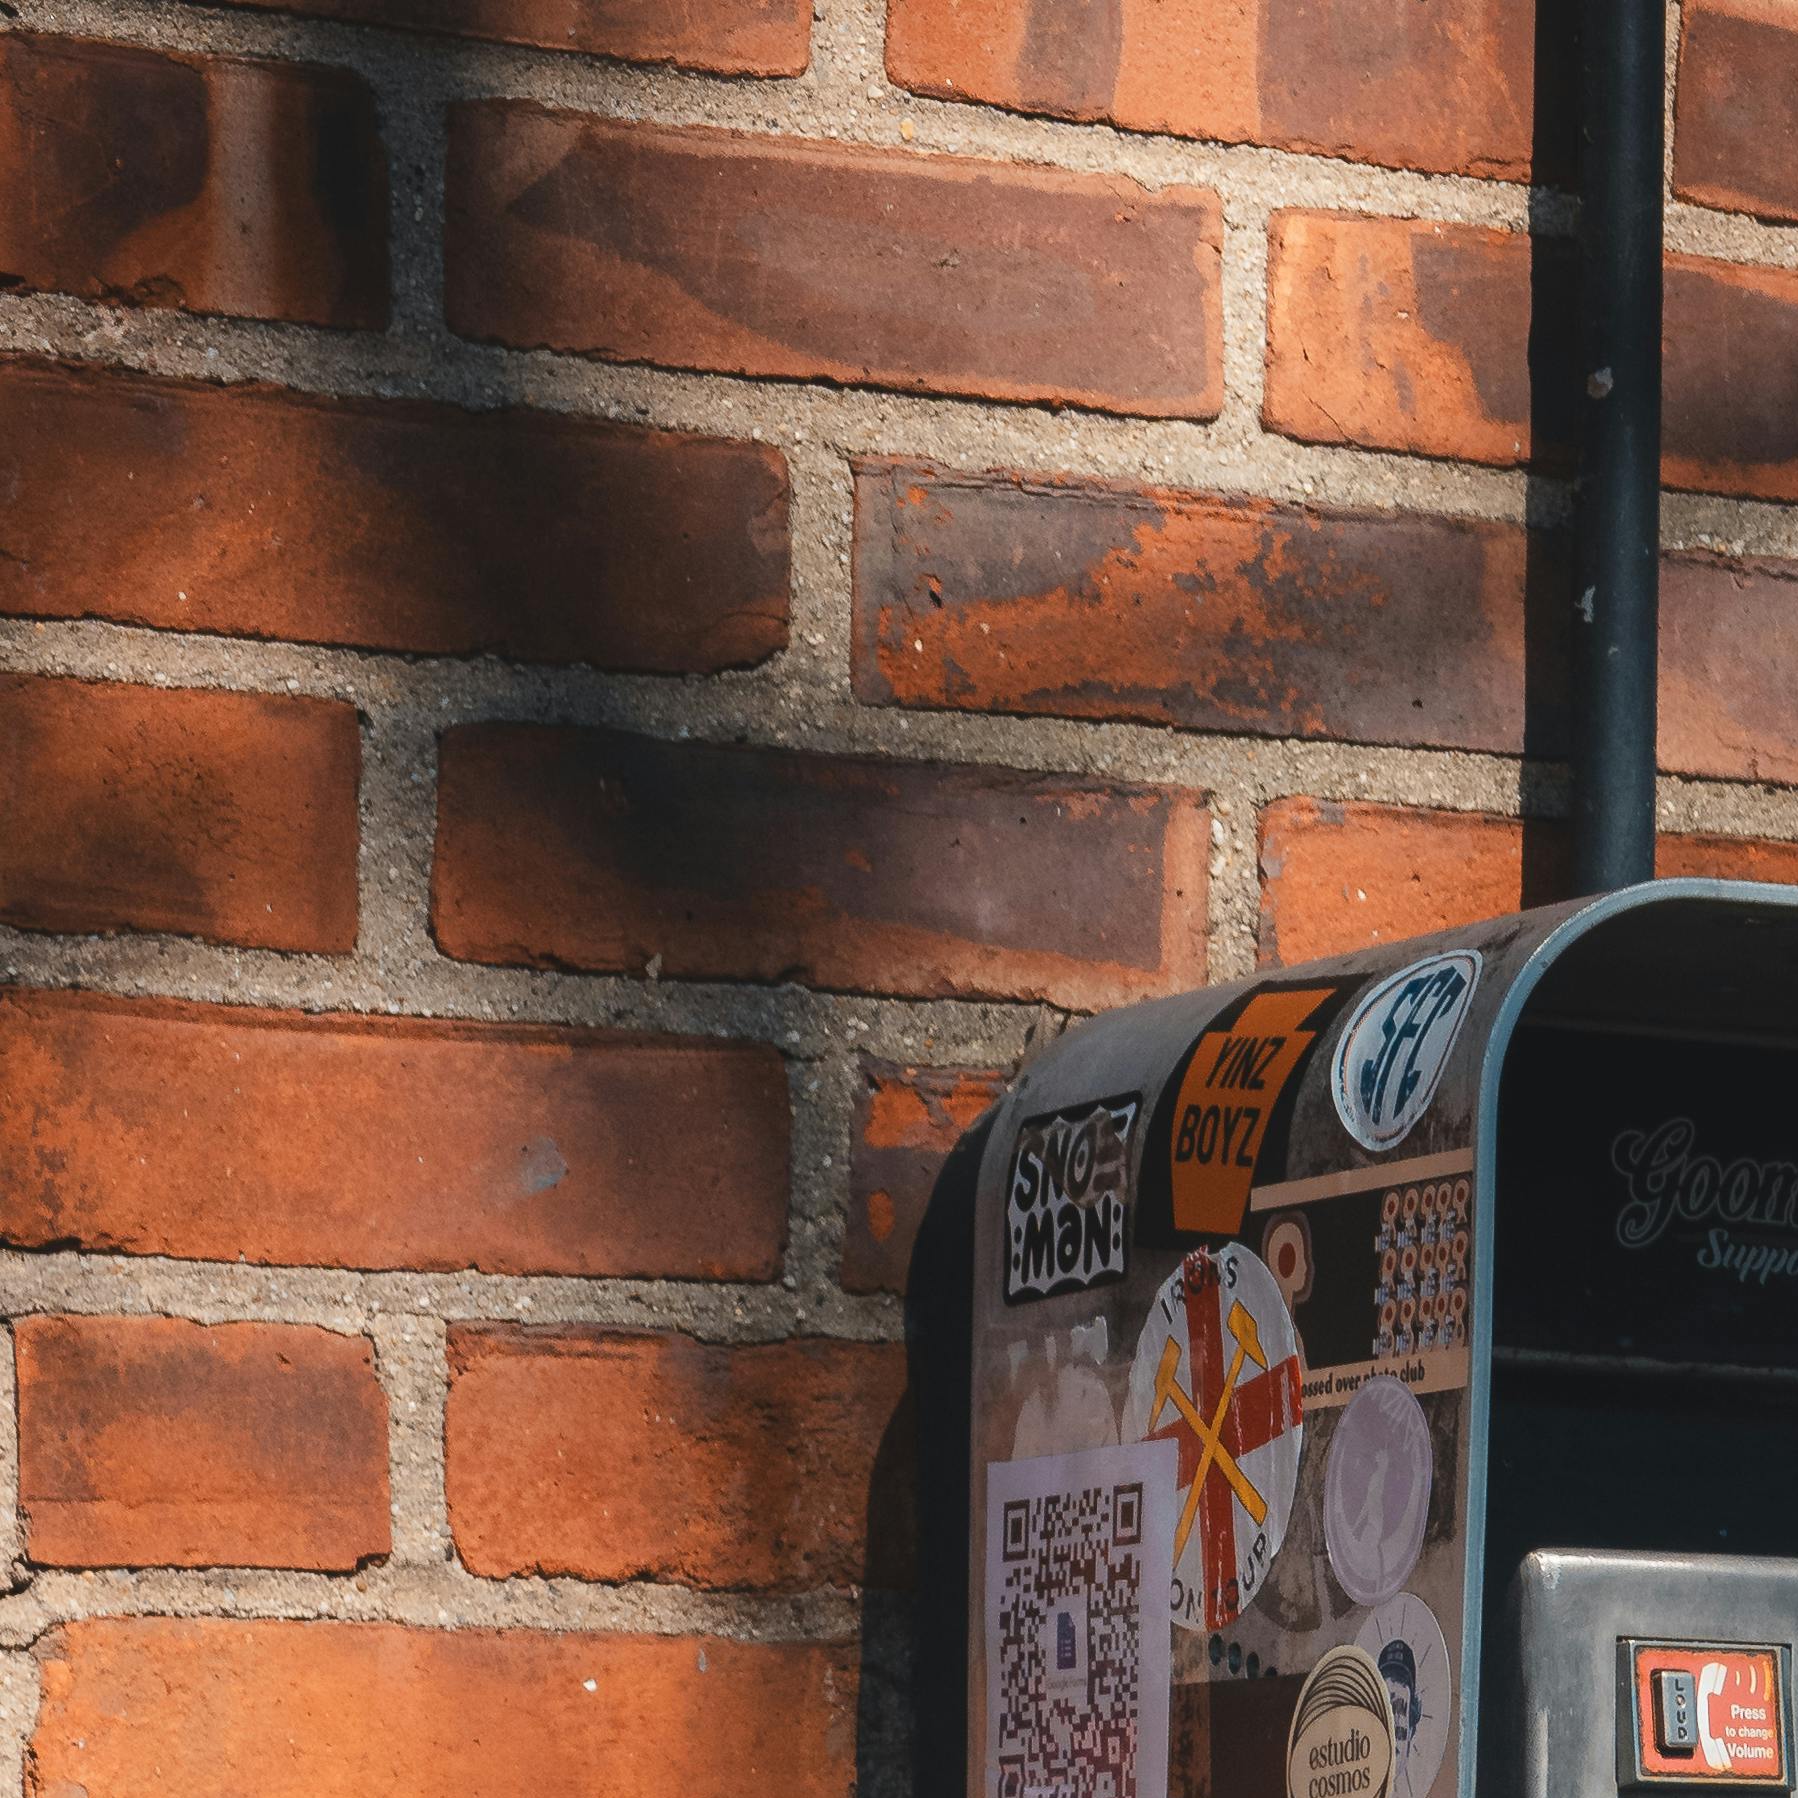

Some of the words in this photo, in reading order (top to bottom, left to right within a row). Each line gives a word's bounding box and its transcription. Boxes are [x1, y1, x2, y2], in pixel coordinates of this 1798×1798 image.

[1204, 1034, 1286, 1090] YINZ
[1175, 1105, 1260, 1168] BOYZ
[1336, 1374, 1361, 1393] over
[1400, 1358, 1426, 1383] club
[1674, 1678, 1689, 1741] LOUD
[1731, 1704, 1767, 1721] Press
[1308, 1728, 1372, 1770] estudio
[1725, 1726, 1738, 1738] to
[1738, 1726, 1775, 1741] change
[1727, 1742, 1774, 1759] Volume
